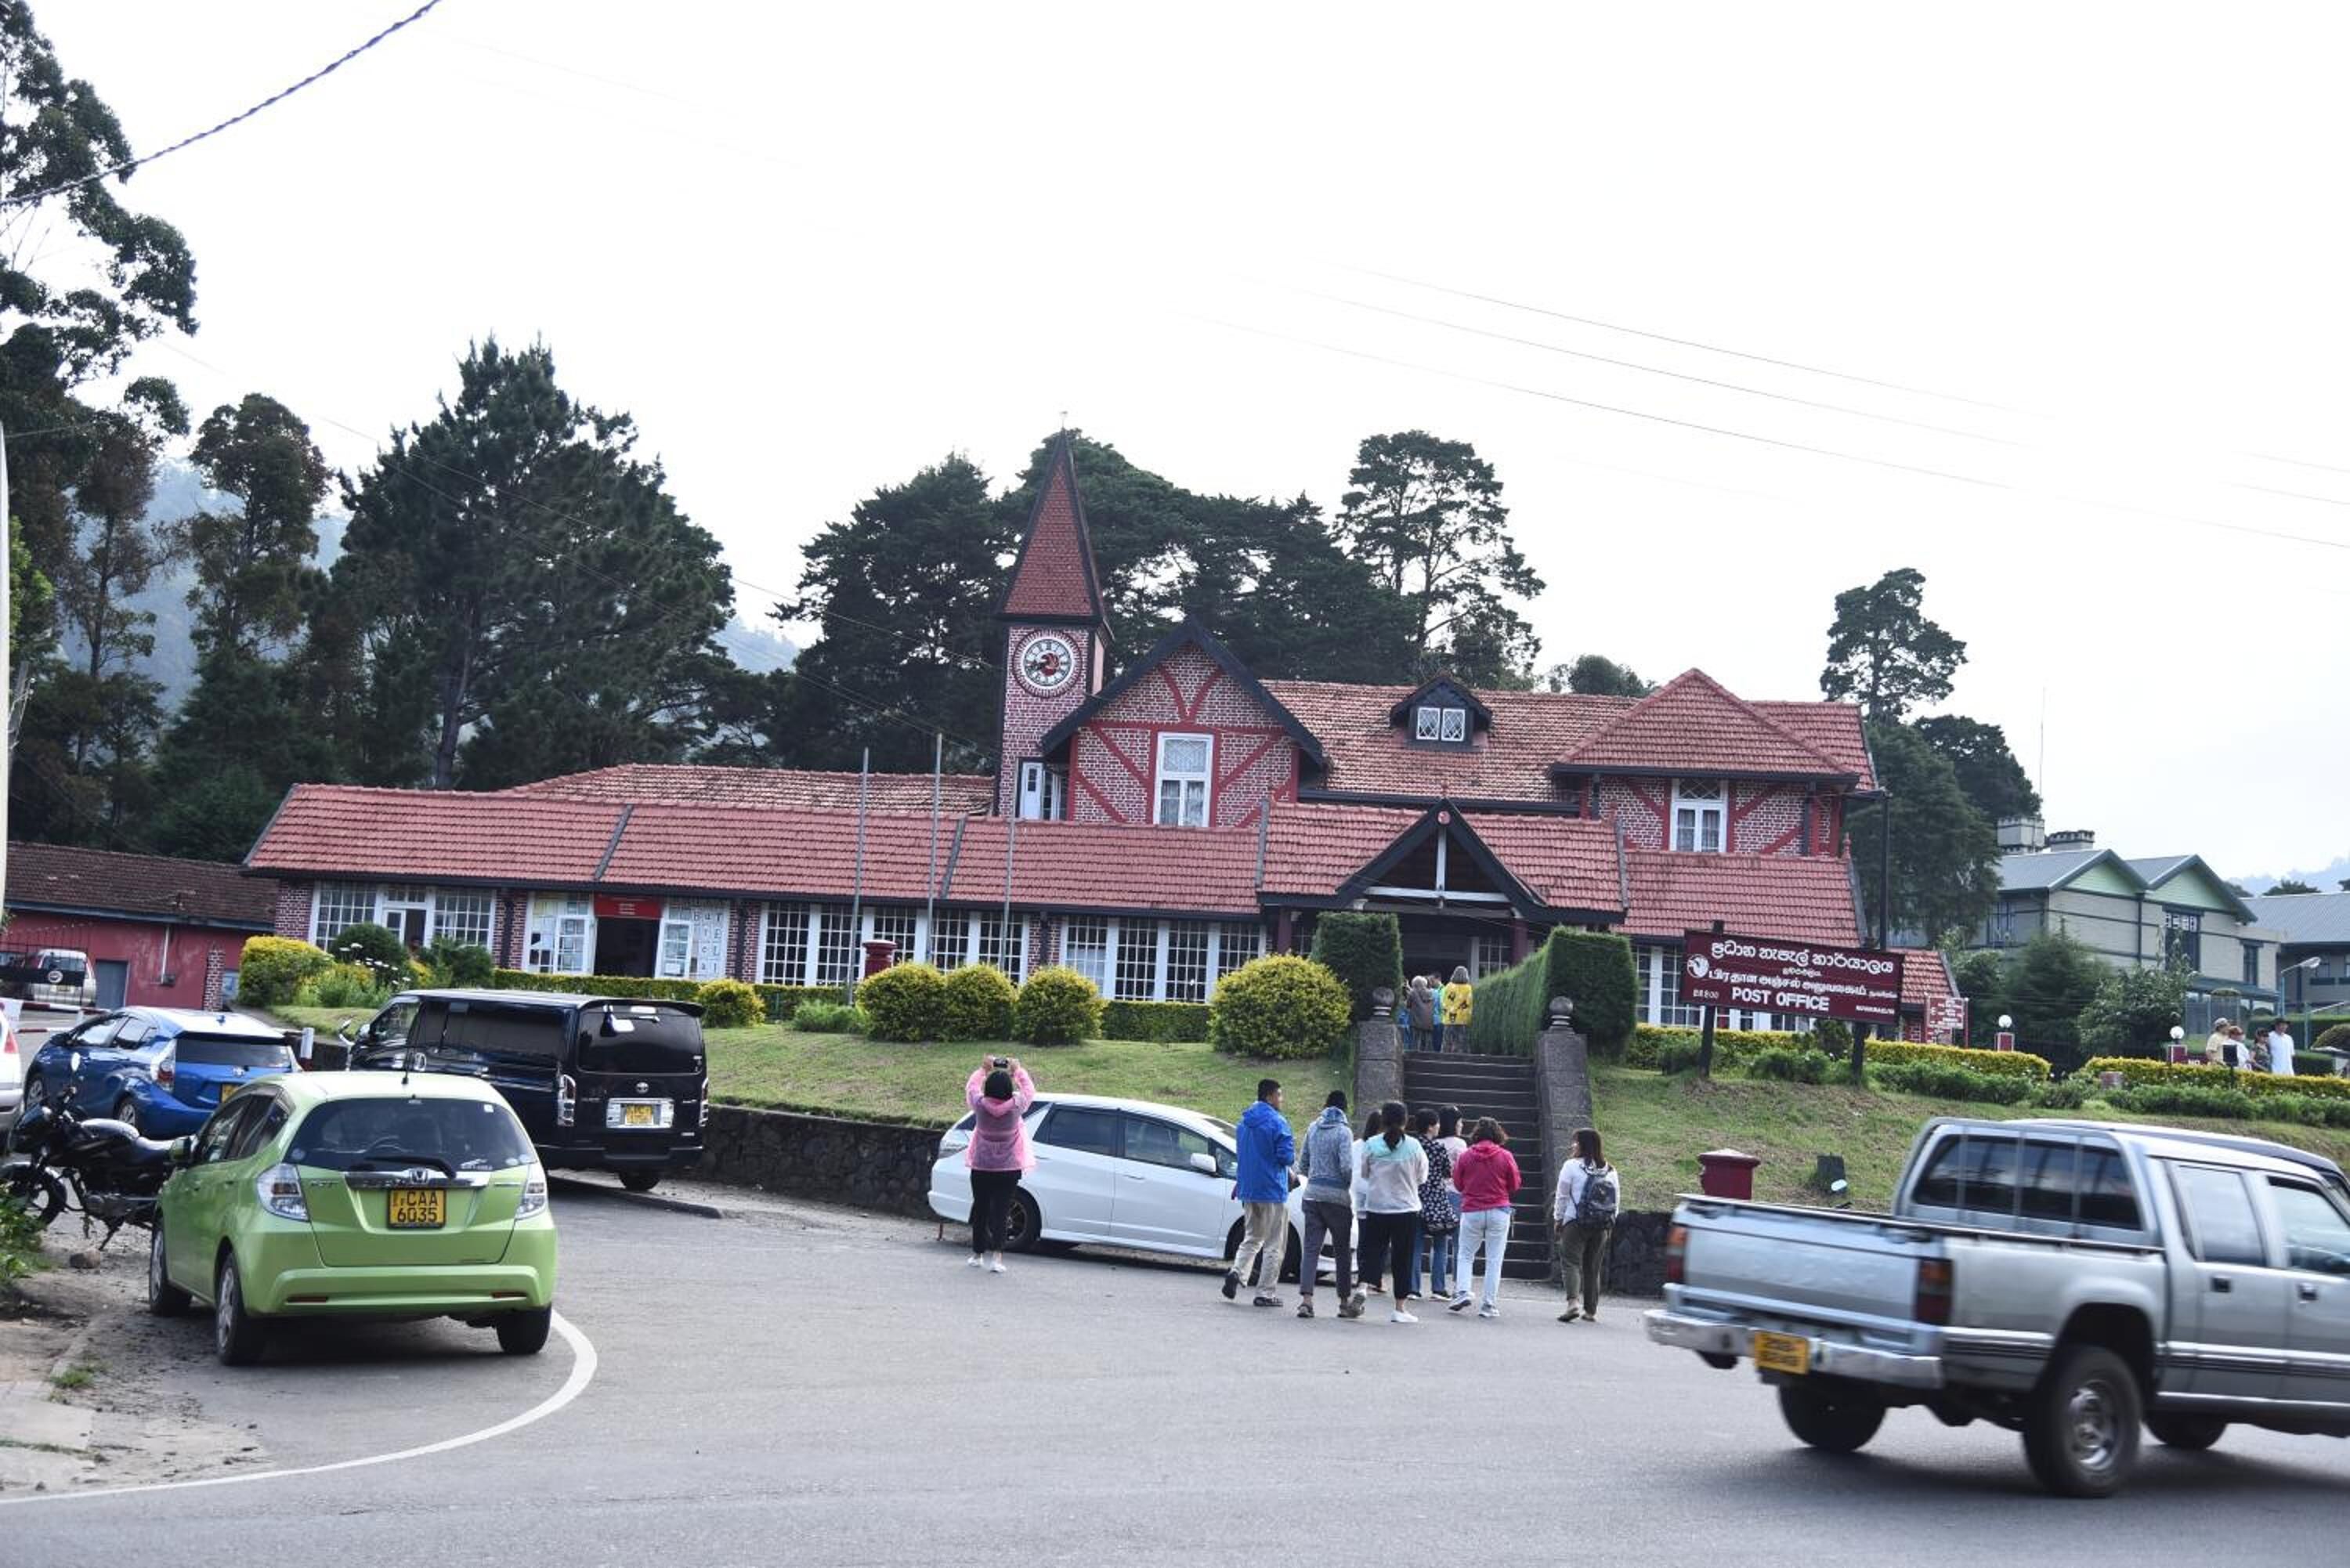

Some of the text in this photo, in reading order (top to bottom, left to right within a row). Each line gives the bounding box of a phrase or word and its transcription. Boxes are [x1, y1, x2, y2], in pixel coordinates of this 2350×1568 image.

[1731, 987, 1771, 1005] POST
[1776, 992, 1830, 1011] OFFICE
[407, 1190, 439, 1206] CAA
[397, 1207, 438, 1223] 6035
